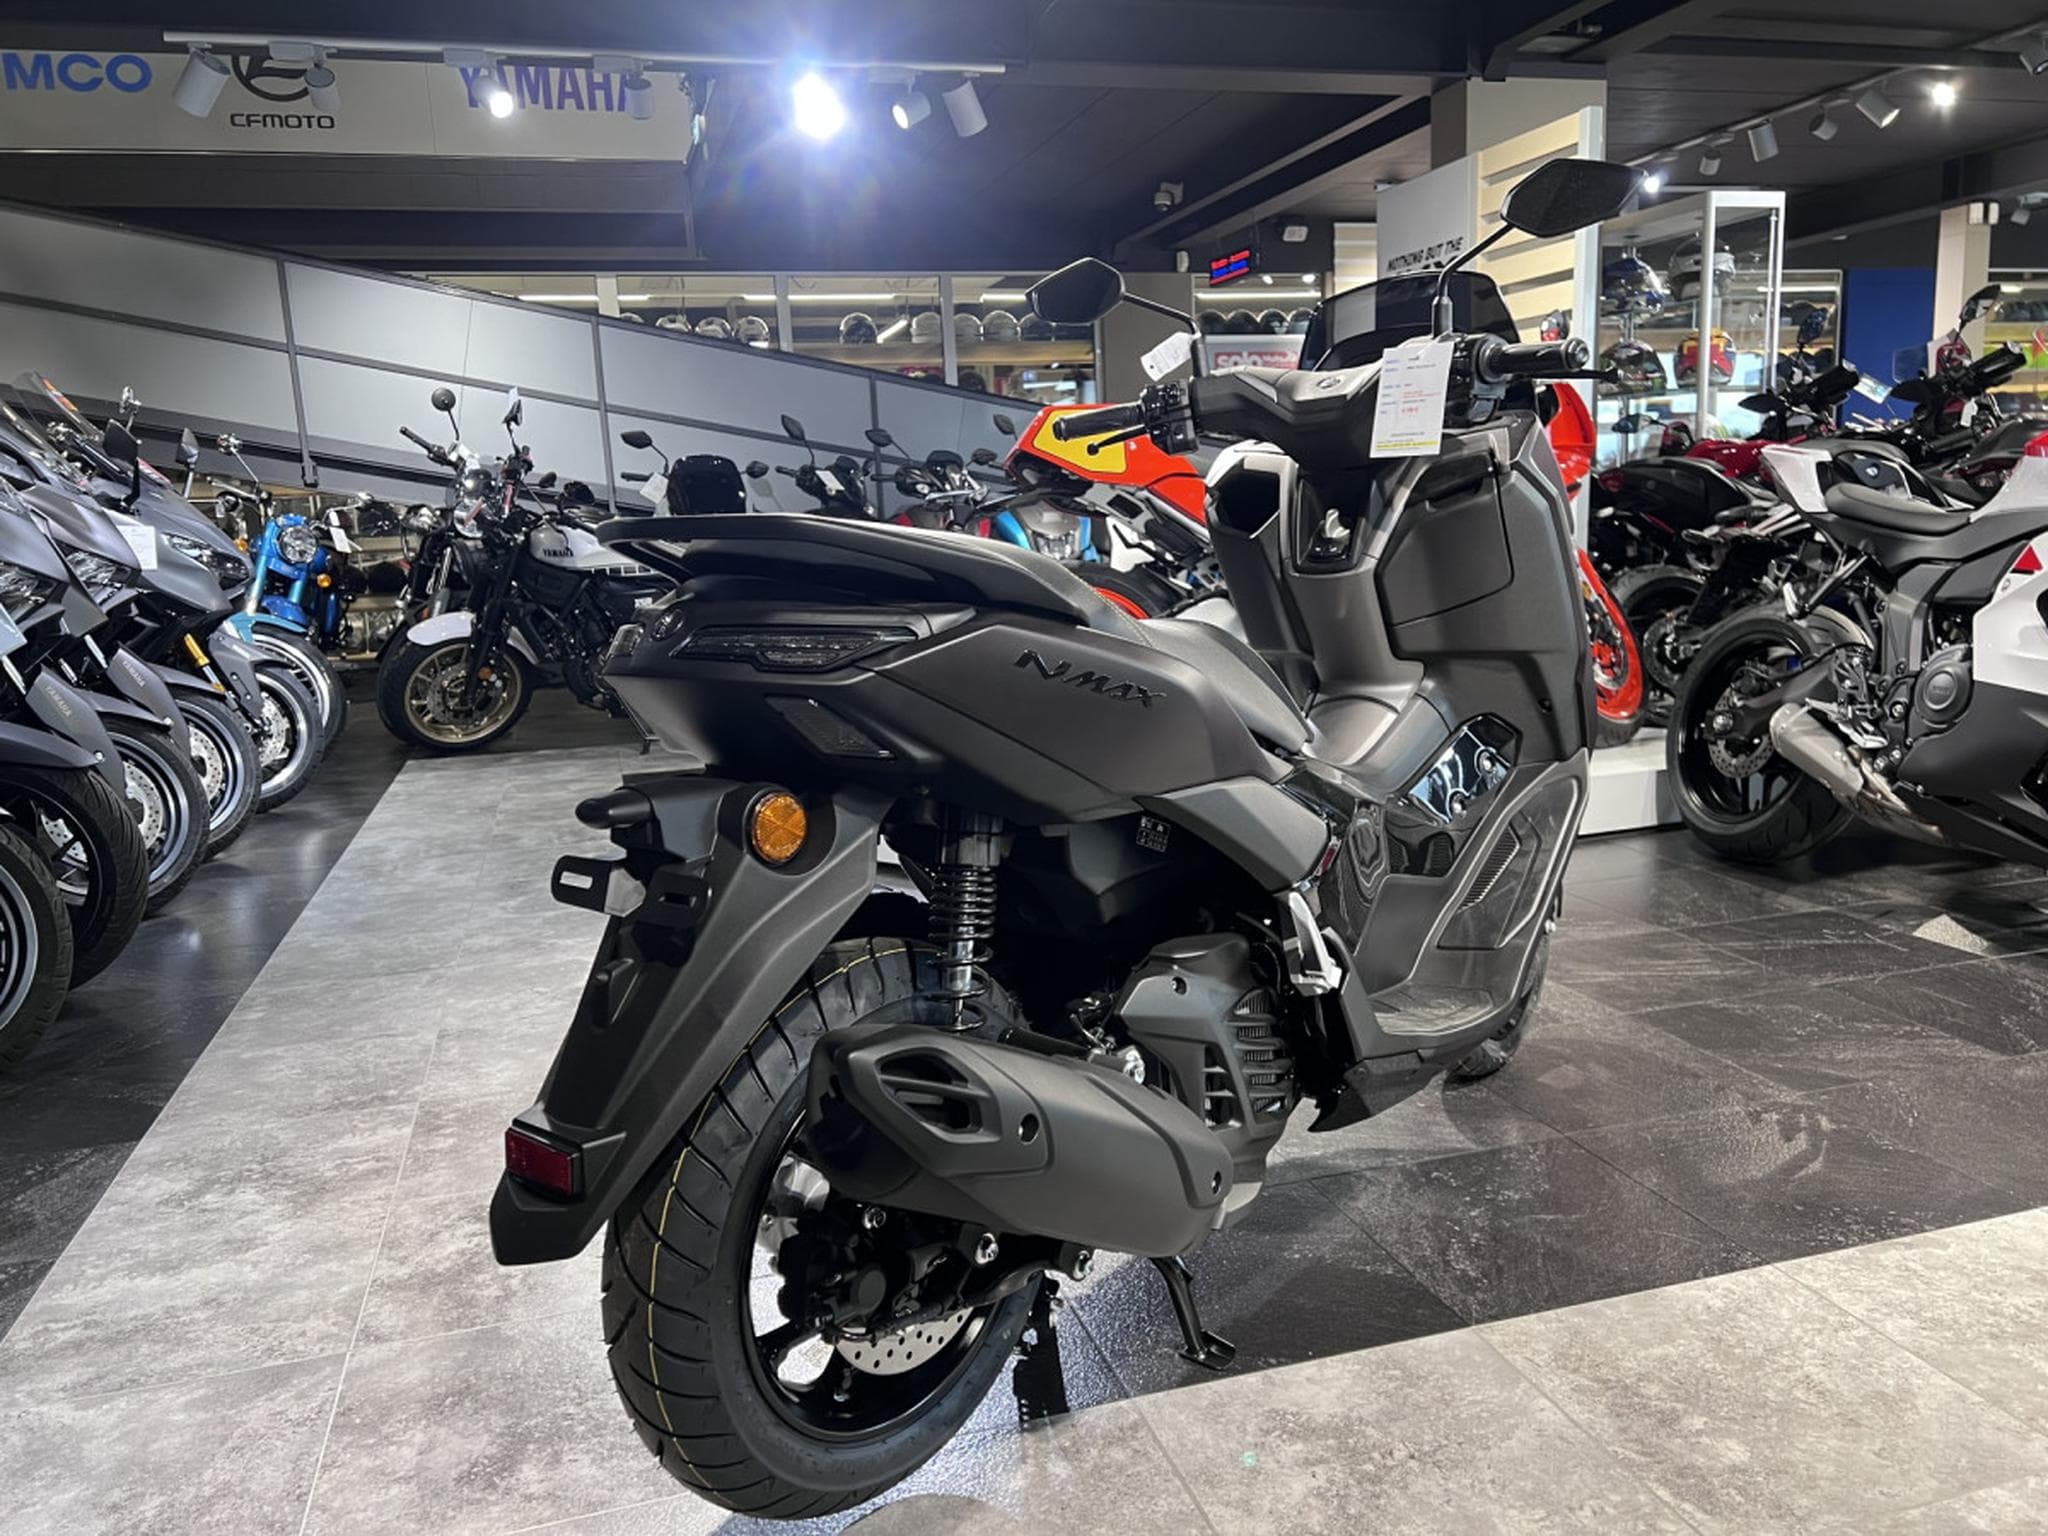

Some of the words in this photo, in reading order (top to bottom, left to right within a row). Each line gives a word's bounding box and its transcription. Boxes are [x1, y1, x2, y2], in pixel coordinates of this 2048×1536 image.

[230, 113, 335, 129] CFMOTO
[1386, 249, 1425, 272] NOTHING
[1425, 242, 1445, 262] BUT
[1444, 236, 1464, 256] THE
